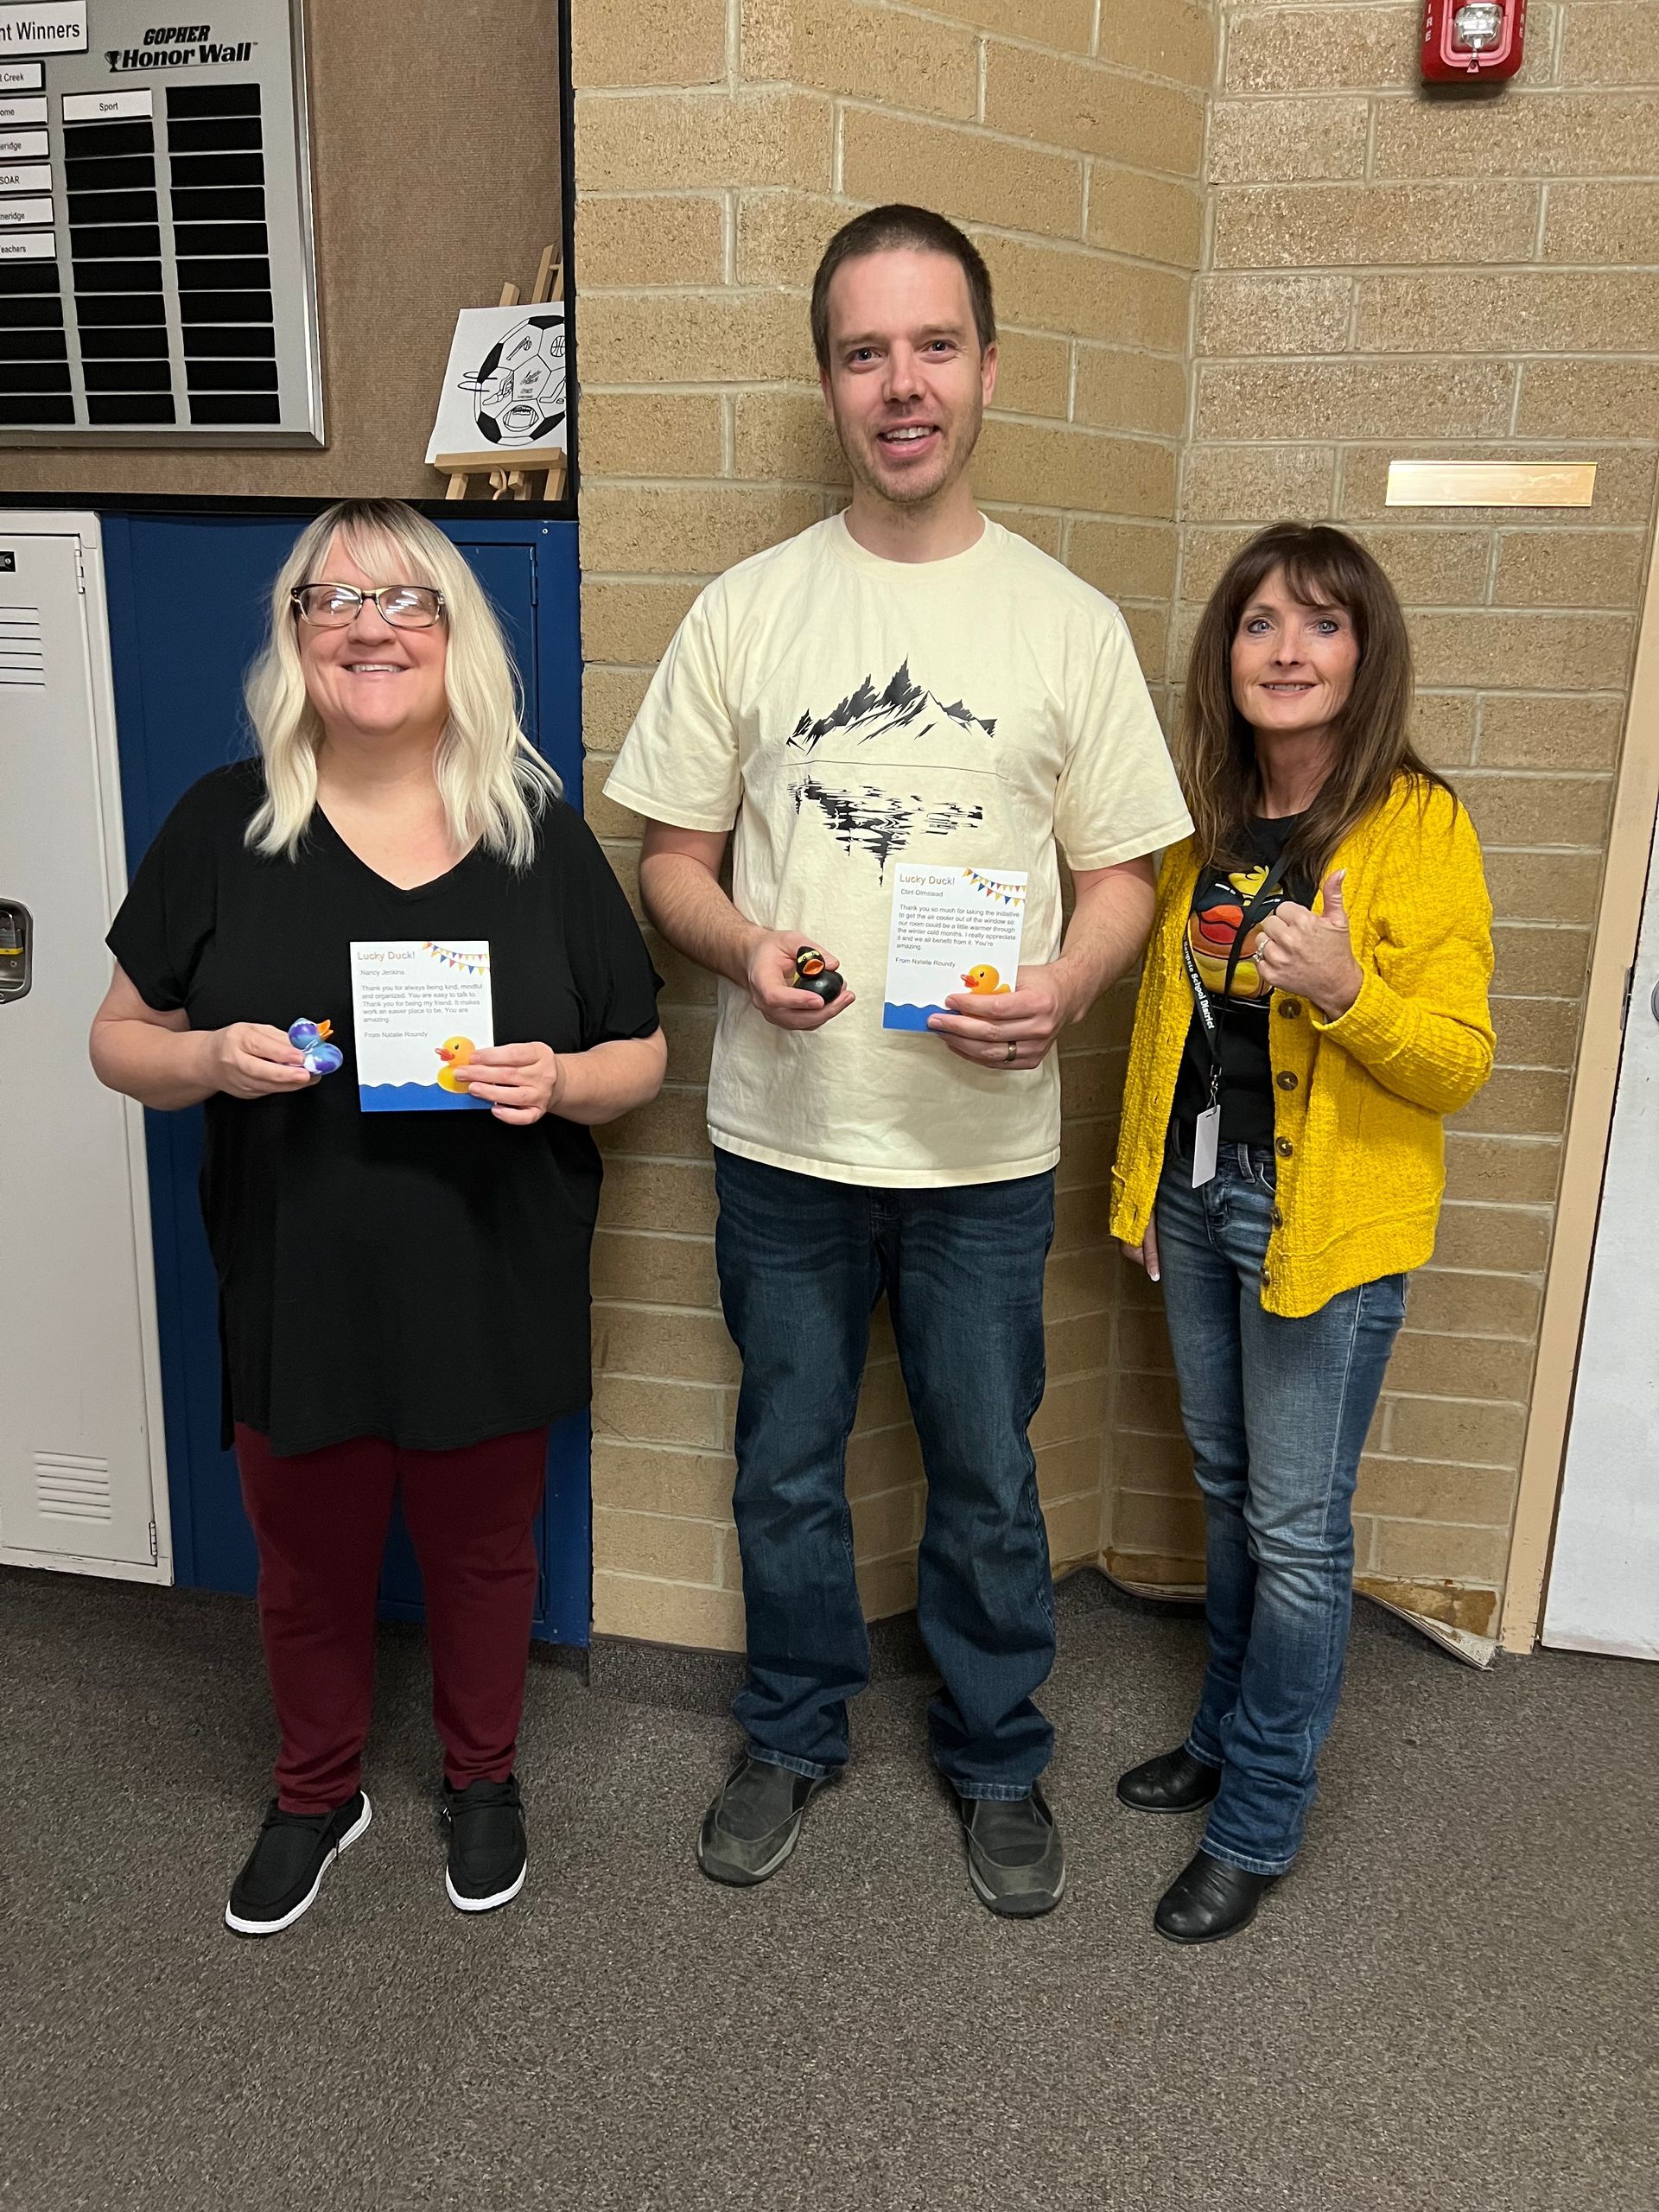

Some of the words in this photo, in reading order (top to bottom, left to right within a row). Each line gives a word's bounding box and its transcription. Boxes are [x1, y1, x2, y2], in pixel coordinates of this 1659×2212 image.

[16, 21, 80, 41] Winners
[143, 25, 211, 46] GOPHER
[122, 48, 196, 68] Honor
[199, 41, 252, 63] Wall
[3, 73, 24, 82] Creek
[99, 102, 118, 113] Sport
[899, 874, 925, 886] Lucky
[928, 875, 956, 886] Duck!
[357, 951, 385, 962] Lucky
[388, 950, 416, 961] Duck!
[933, 959, 956, 968] Roundy
[1191, 973, 1207, 1000] School
[1199, 999, 1215, 1030] District
